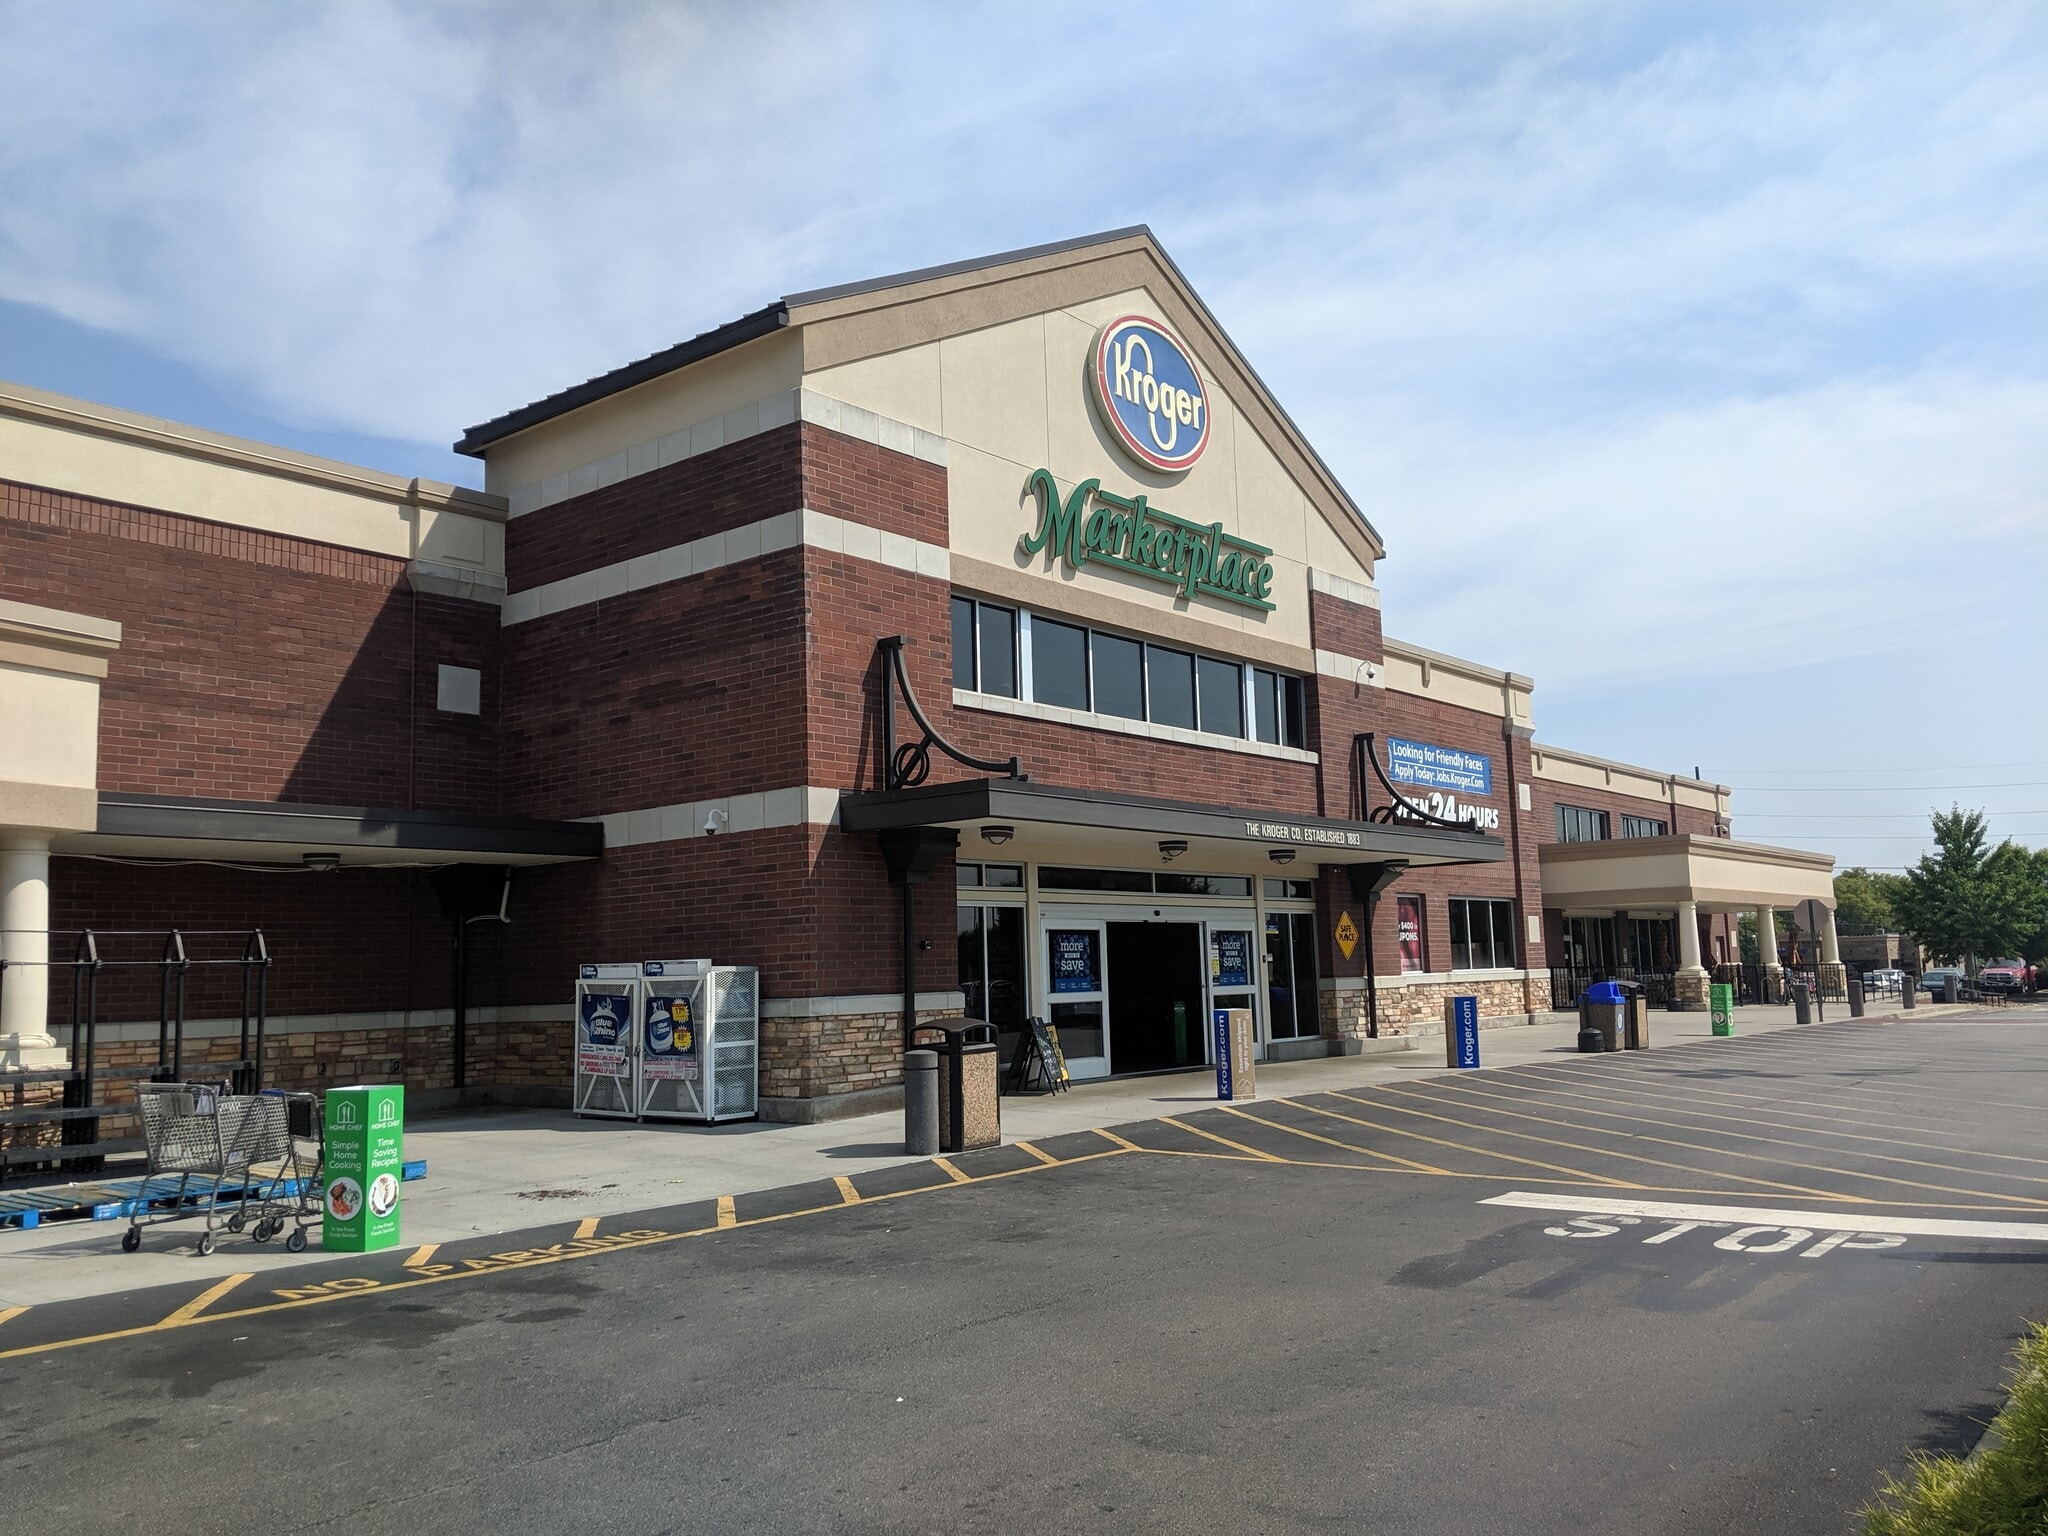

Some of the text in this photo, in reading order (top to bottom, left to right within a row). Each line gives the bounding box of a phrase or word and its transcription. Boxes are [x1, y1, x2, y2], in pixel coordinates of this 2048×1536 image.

[1114, 334, 1203, 451] Kroger
[1024, 468, 1275, 604] Marketplace
[1392, 742, 1483, 771] Looking for Friendly Faces
[1394, 763, 1485, 789] Apply Today: Jobs.Kroger.Com
[1431, 792, 1457, 827] 24
[1458, 804, 1499, 829] HOURS
[1245, 822, 1360, 846] THE KROGER CO. ESTABLISHED 1883
[1340, 924, 1352, 933] SAFE
[1401, 921, 1414, 930] $400
[1338, 933, 1355, 942] PLACE
[1060, 942, 1084, 951] more
[1222, 941, 1241, 950] more
[1060, 960, 1085, 971] save
[1223, 957, 1242, 967] save
[595, 1018, 613, 1027] Blue
[1463, 1000, 1475, 1065] Kroger.com
[1218, 1015, 1229, 1094] Kroger.com
[371, 1119, 401, 1130] HOME CHEF
[331, 1140, 360, 1151] Simple
[376, 1138, 395, 1147] Time
[333, 1151, 358, 1159] Home
[373, 1147, 398, 1158] Saving
[328, 1160, 362, 1172] Cooking
[371, 1157, 399, 1168] Recipes
[1543, 1214, 1908, 1258] STOP
[271, 1229, 669, 1299] NO PARKING
